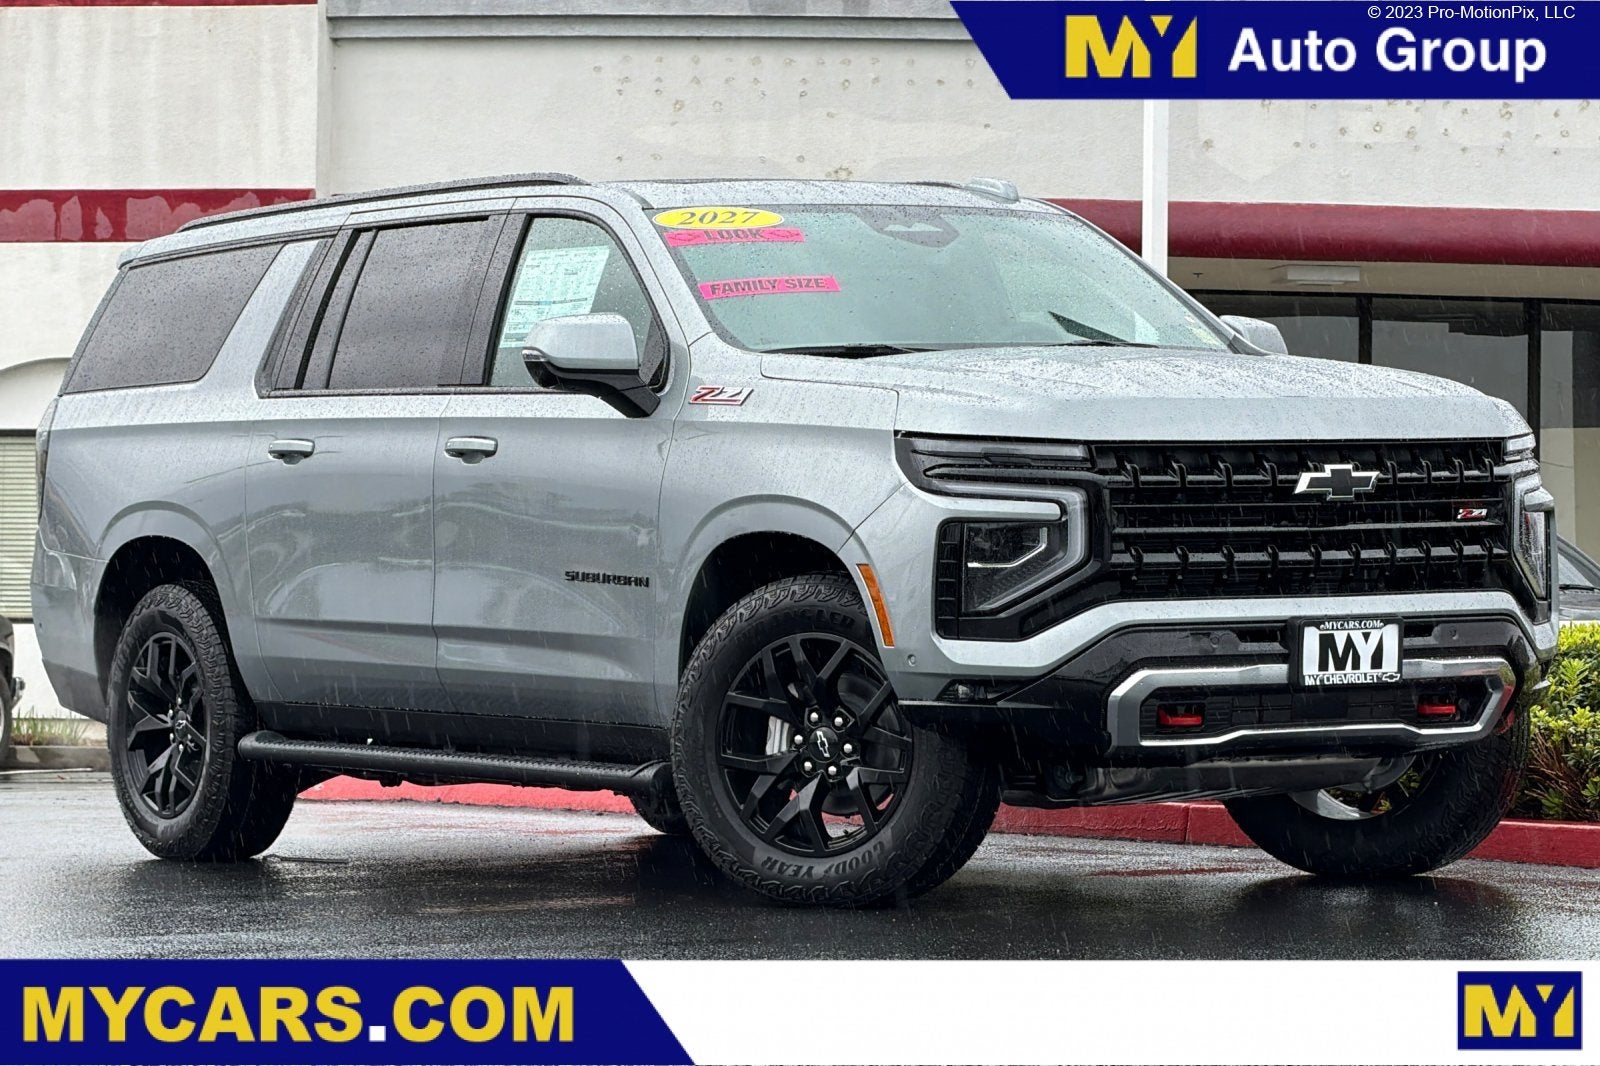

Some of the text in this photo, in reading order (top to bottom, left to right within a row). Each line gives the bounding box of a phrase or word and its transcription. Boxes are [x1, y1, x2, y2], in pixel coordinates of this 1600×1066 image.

[677, 211, 760, 226] 2027
[703, 229, 764, 241] LOOK
[709, 277, 826, 296] FAMILY SIZE
[689, 385, 754, 406] Z71
[564, 570, 650, 588] SUBURBAN
[1324, 620, 1381, 630] MYCARS.COM
[1318, 631, 1384, 672] MY
[1304, 673, 1379, 686] MY CHEVROLET
